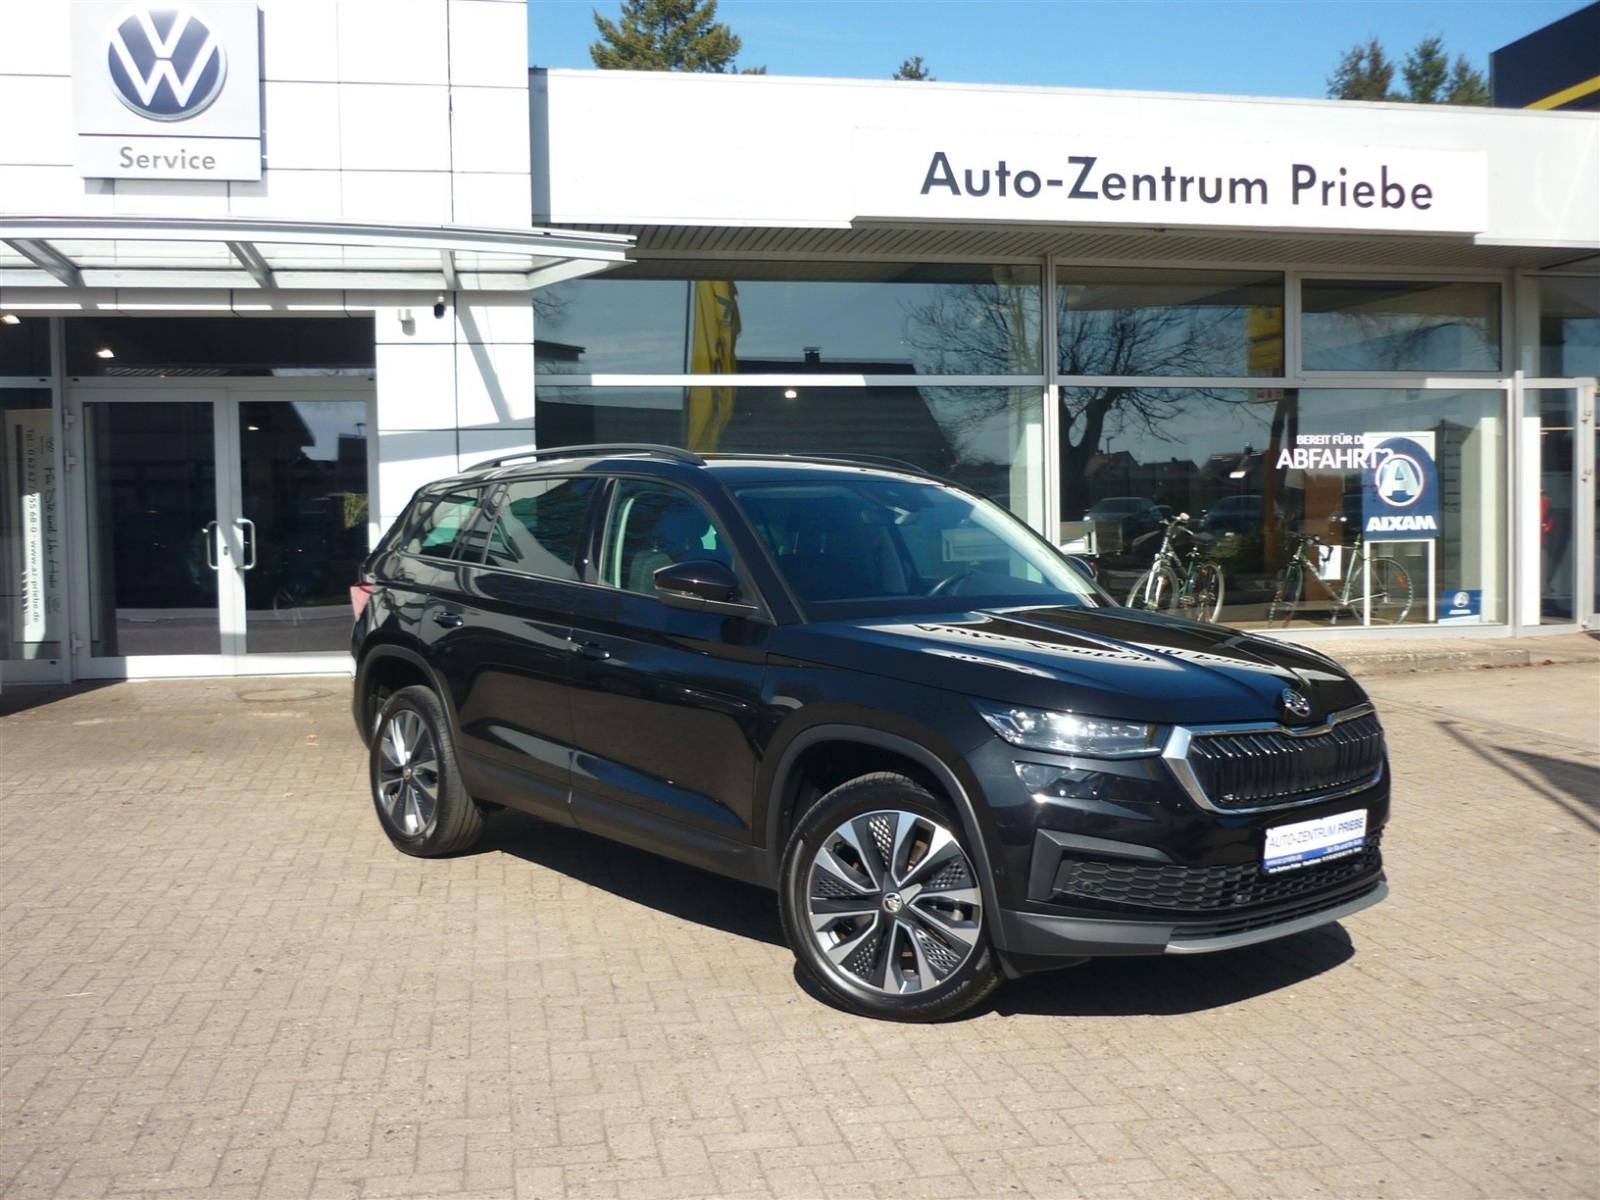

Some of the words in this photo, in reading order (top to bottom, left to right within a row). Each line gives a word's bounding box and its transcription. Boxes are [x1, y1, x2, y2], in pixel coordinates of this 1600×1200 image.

[119, 146, 216, 170] Service
[920, 151, 1268, 205] Auto-Zentrum
[1291, 163, 1433, 211] Priebe
[1296, 435, 1331, 445] BEREIT
[1332, 432, 1353, 445] FÜR
[1366, 514, 1438, 532] AIXAM
[1338, 817, 1364, 833] PRIEBE
